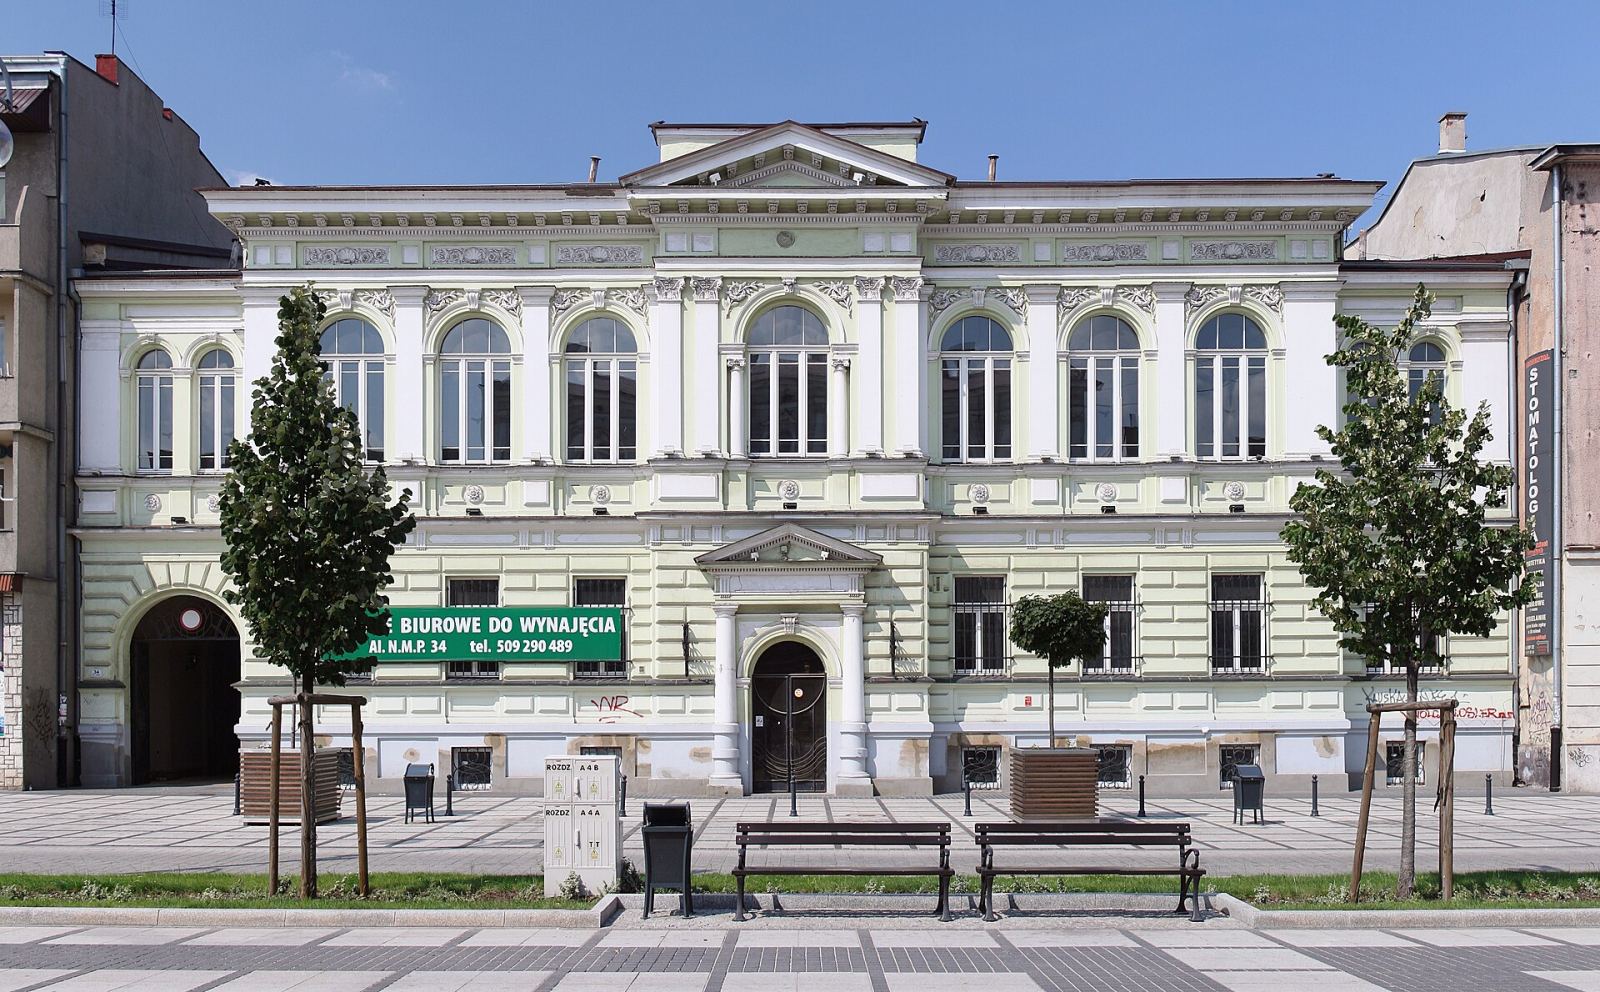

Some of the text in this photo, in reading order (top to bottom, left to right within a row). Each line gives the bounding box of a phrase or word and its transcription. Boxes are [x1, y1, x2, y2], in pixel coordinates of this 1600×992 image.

[400, 616, 481, 634] BIUROWE
[488, 616, 513, 634] DO
[519, 616, 617, 638] WYNAJĘCIA
[368, 639, 573, 654] Al. N.M.P. 34 tel. 509 290 489
